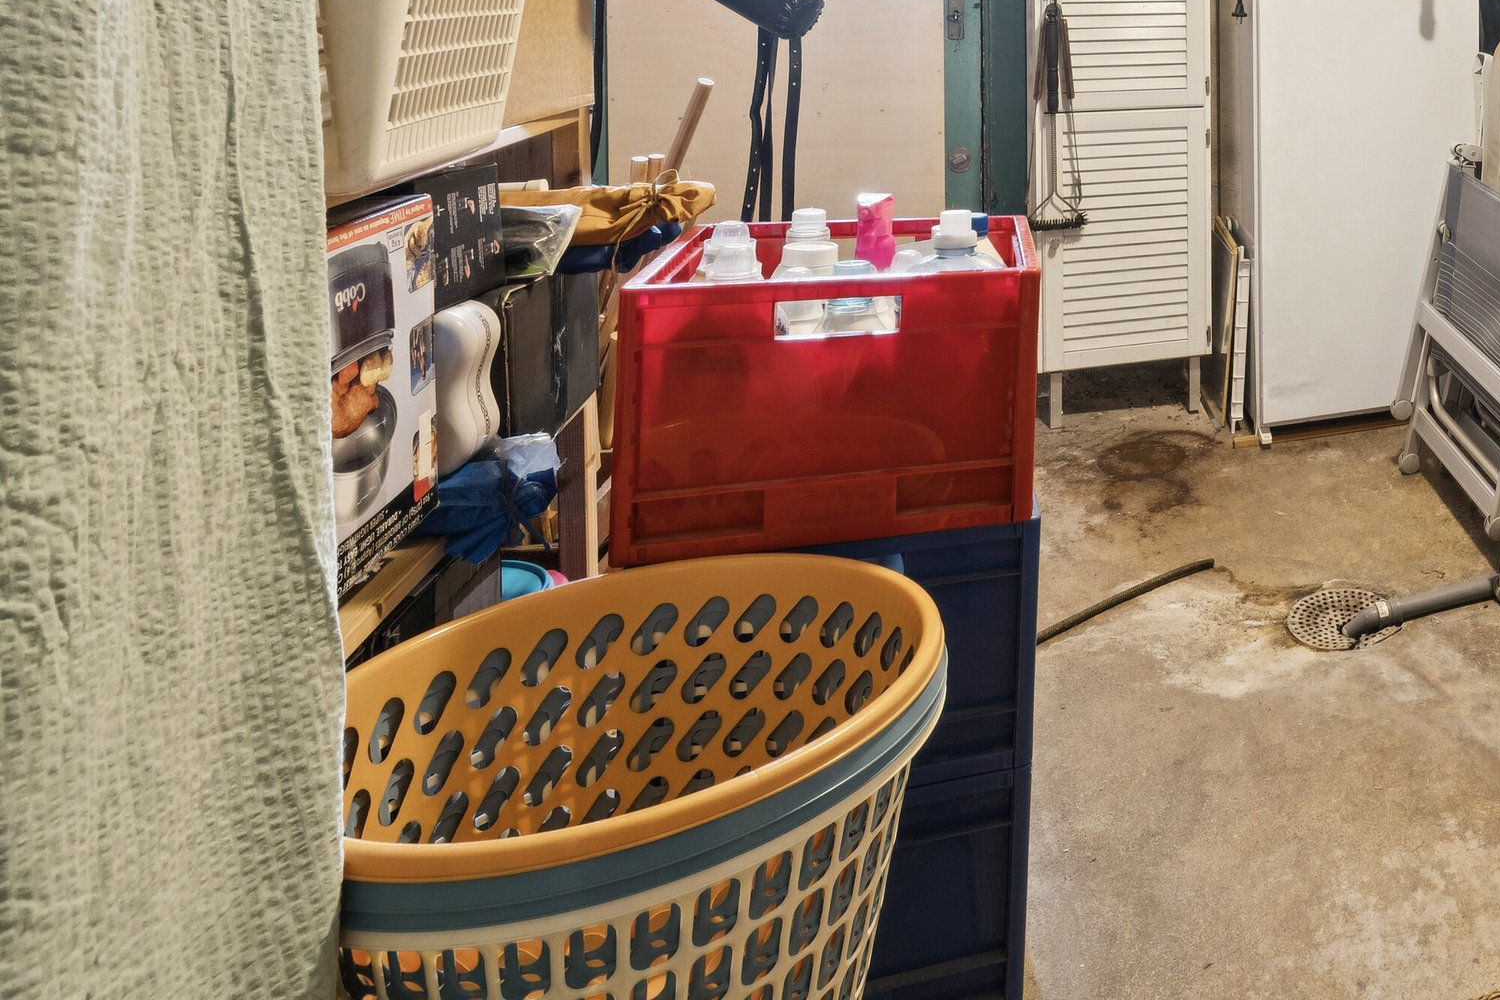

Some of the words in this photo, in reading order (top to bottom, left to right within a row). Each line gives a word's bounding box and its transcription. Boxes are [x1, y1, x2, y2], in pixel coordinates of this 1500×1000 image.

[389, 208, 406, 224] TIME
[339, 232, 348, 241] the
[354, 226, 363, 235] one
[334, 282, 366, 312] Cobb
